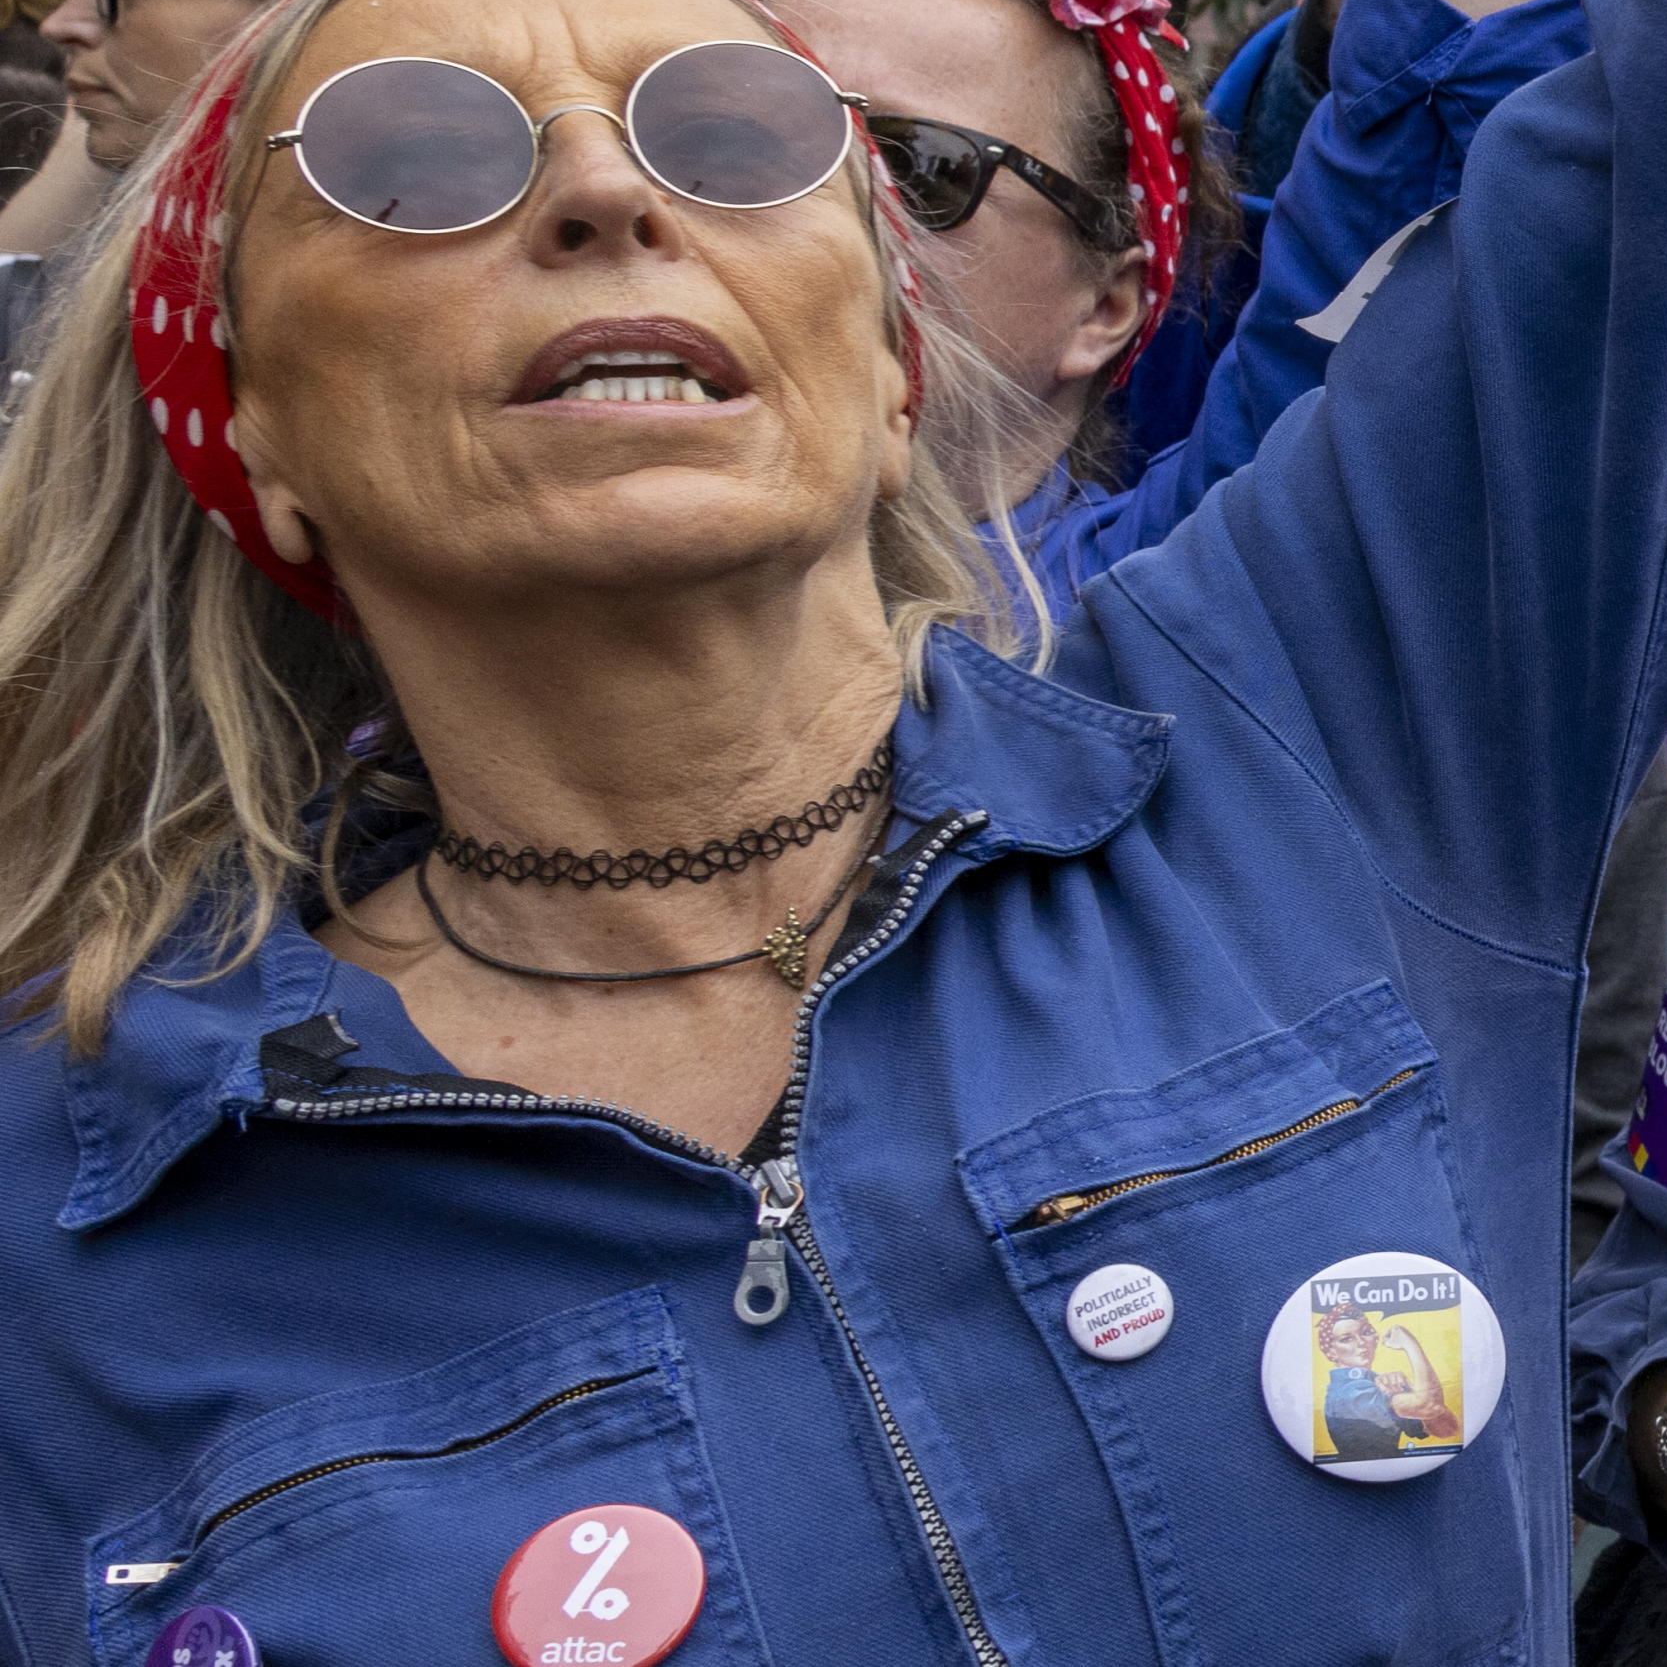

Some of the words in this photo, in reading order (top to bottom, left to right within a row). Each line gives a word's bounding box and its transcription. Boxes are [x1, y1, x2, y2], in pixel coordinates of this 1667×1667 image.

[1075, 1275, 1151, 1317] POLITICALLY
[1315, 1283, 1350, 1306] We
[1354, 1281, 1394, 1304] Can
[1398, 1279, 1428, 1302] Do
[1433, 1276, 1456, 1300] It!
[1087, 1291, 1156, 1332] INCORRECT
[1094, 1327, 1121, 1348] AND
[1122, 1308, 1165, 1334] PROUD
[540, 1636, 627, 1664] attac
